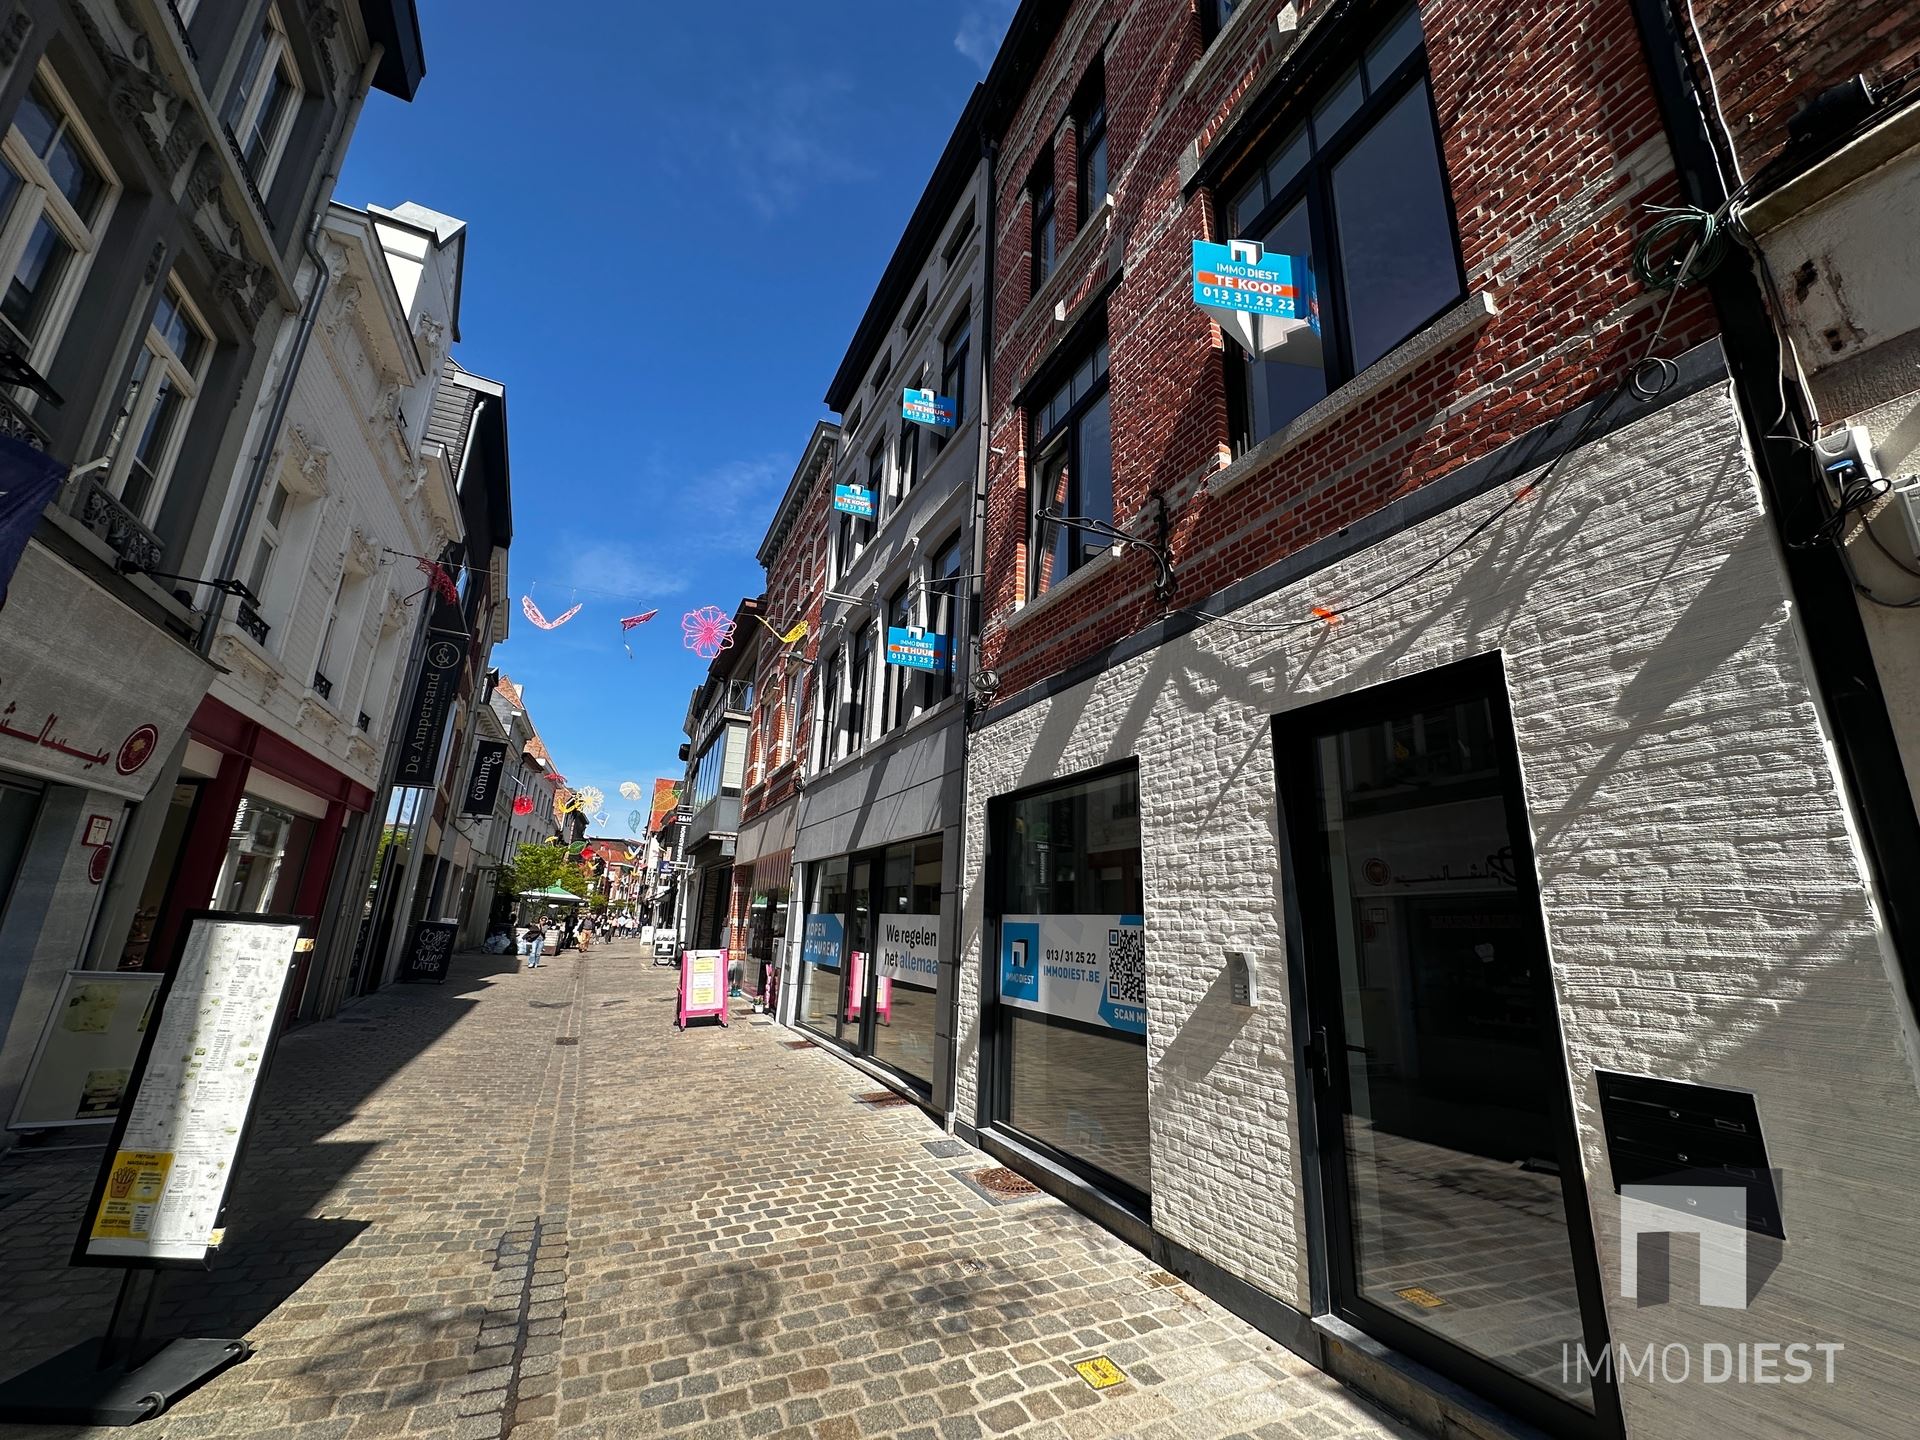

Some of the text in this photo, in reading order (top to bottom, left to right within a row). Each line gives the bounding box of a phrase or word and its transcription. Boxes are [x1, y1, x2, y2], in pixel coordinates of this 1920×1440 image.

[1214, 275, 1282, 295] TE KOOP
[1203, 286, 1295, 311] 013 31 25 22
[913, 404, 945, 416] TE HUUR
[892, 653, 906, 661] 013
[911, 647, 934, 658] HUUR
[405, 673, 440, 773] De Ampersand
[490, 752, 503, 765] ça
[474, 756, 491, 800] comme
[886, 924, 937, 949] We regelen
[805, 940, 840, 957] OF HUREN?
[1046, 949, 1096, 965] 013 / 31 25 22
[412, 960, 440, 972] LATER
[884, 948, 938, 975] het allemaa
[1044, 965, 1100, 983] IMMODIEST.BE
[1114, 1008, 1135, 1022] SCAN
